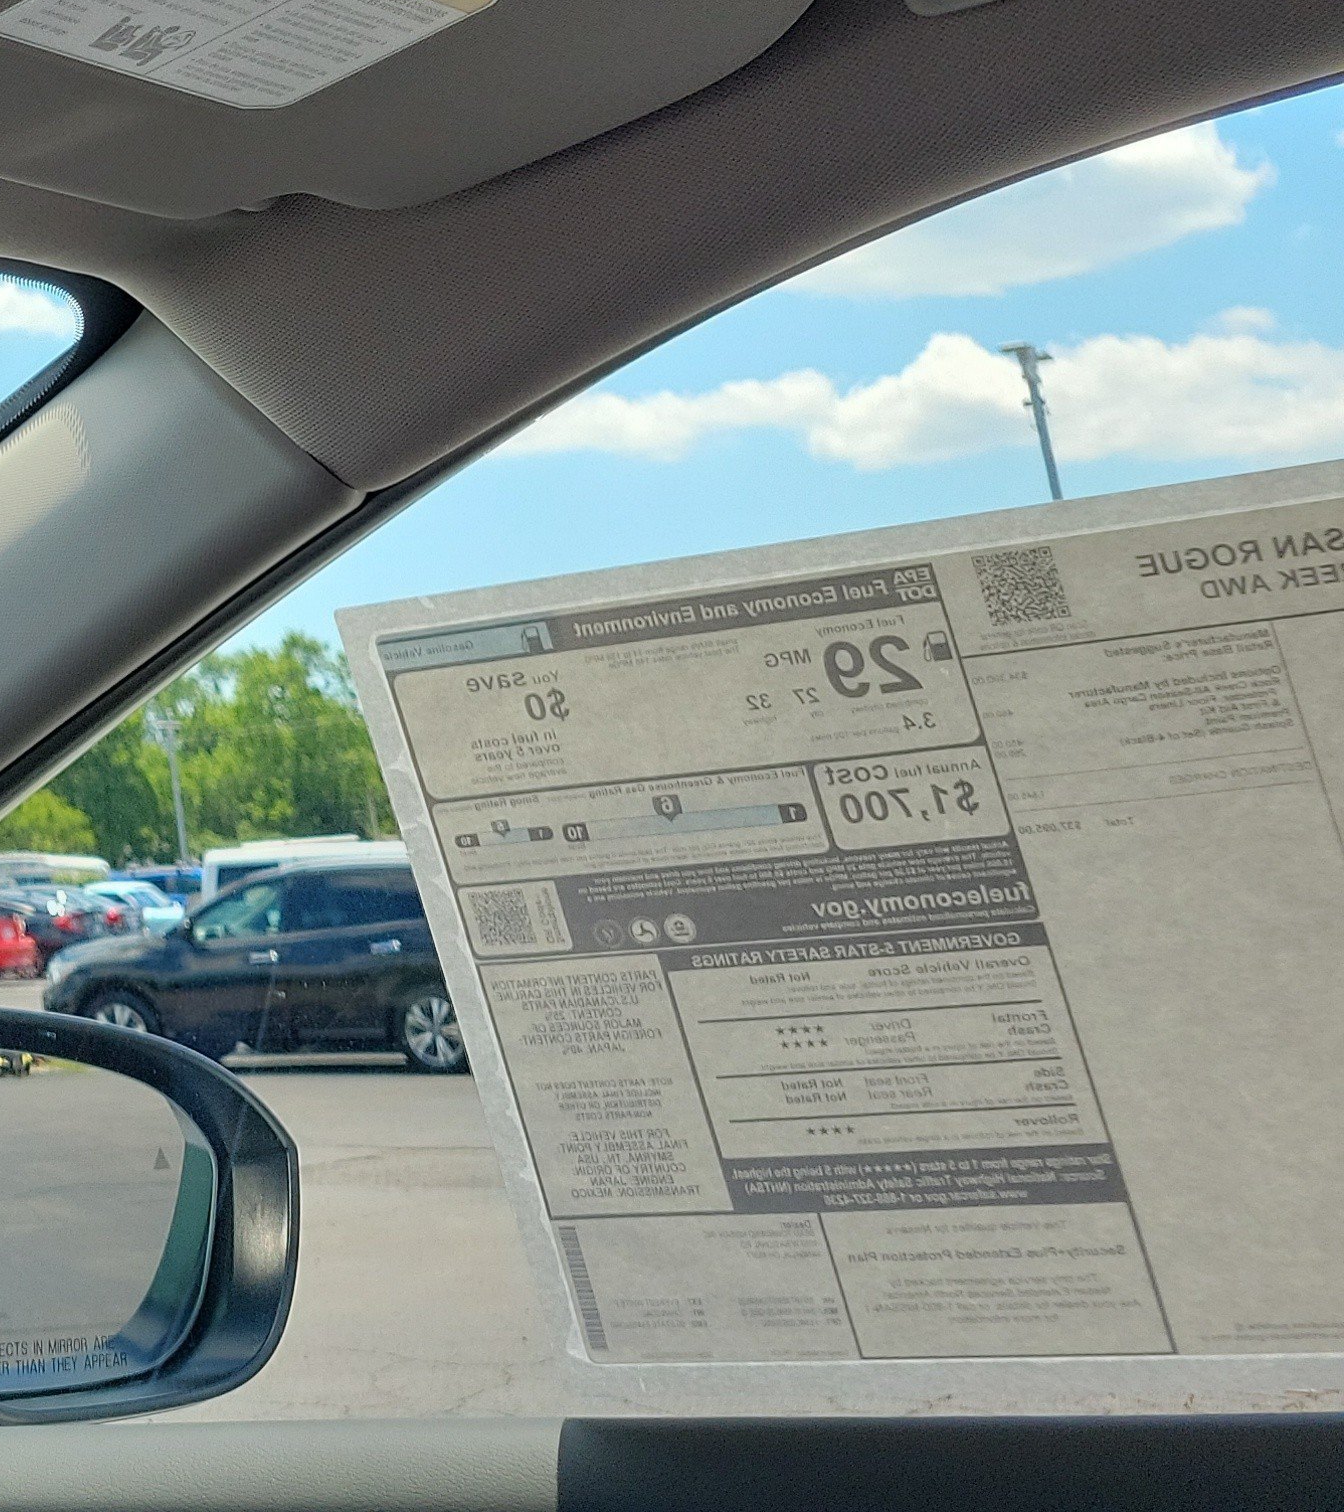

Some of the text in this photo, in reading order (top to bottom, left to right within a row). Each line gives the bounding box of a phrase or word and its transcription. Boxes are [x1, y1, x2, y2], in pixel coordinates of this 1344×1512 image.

[33, 1340, 43, 1355] IN
[48, 1338, 87, 1354] MIRROR
[94, 1336, 118, 1350] ARE
[16, 1358, 45, 1376] THAN
[51, 1356, 77, 1373] THEY
[85, 1352, 128, 1370] APPEAR
